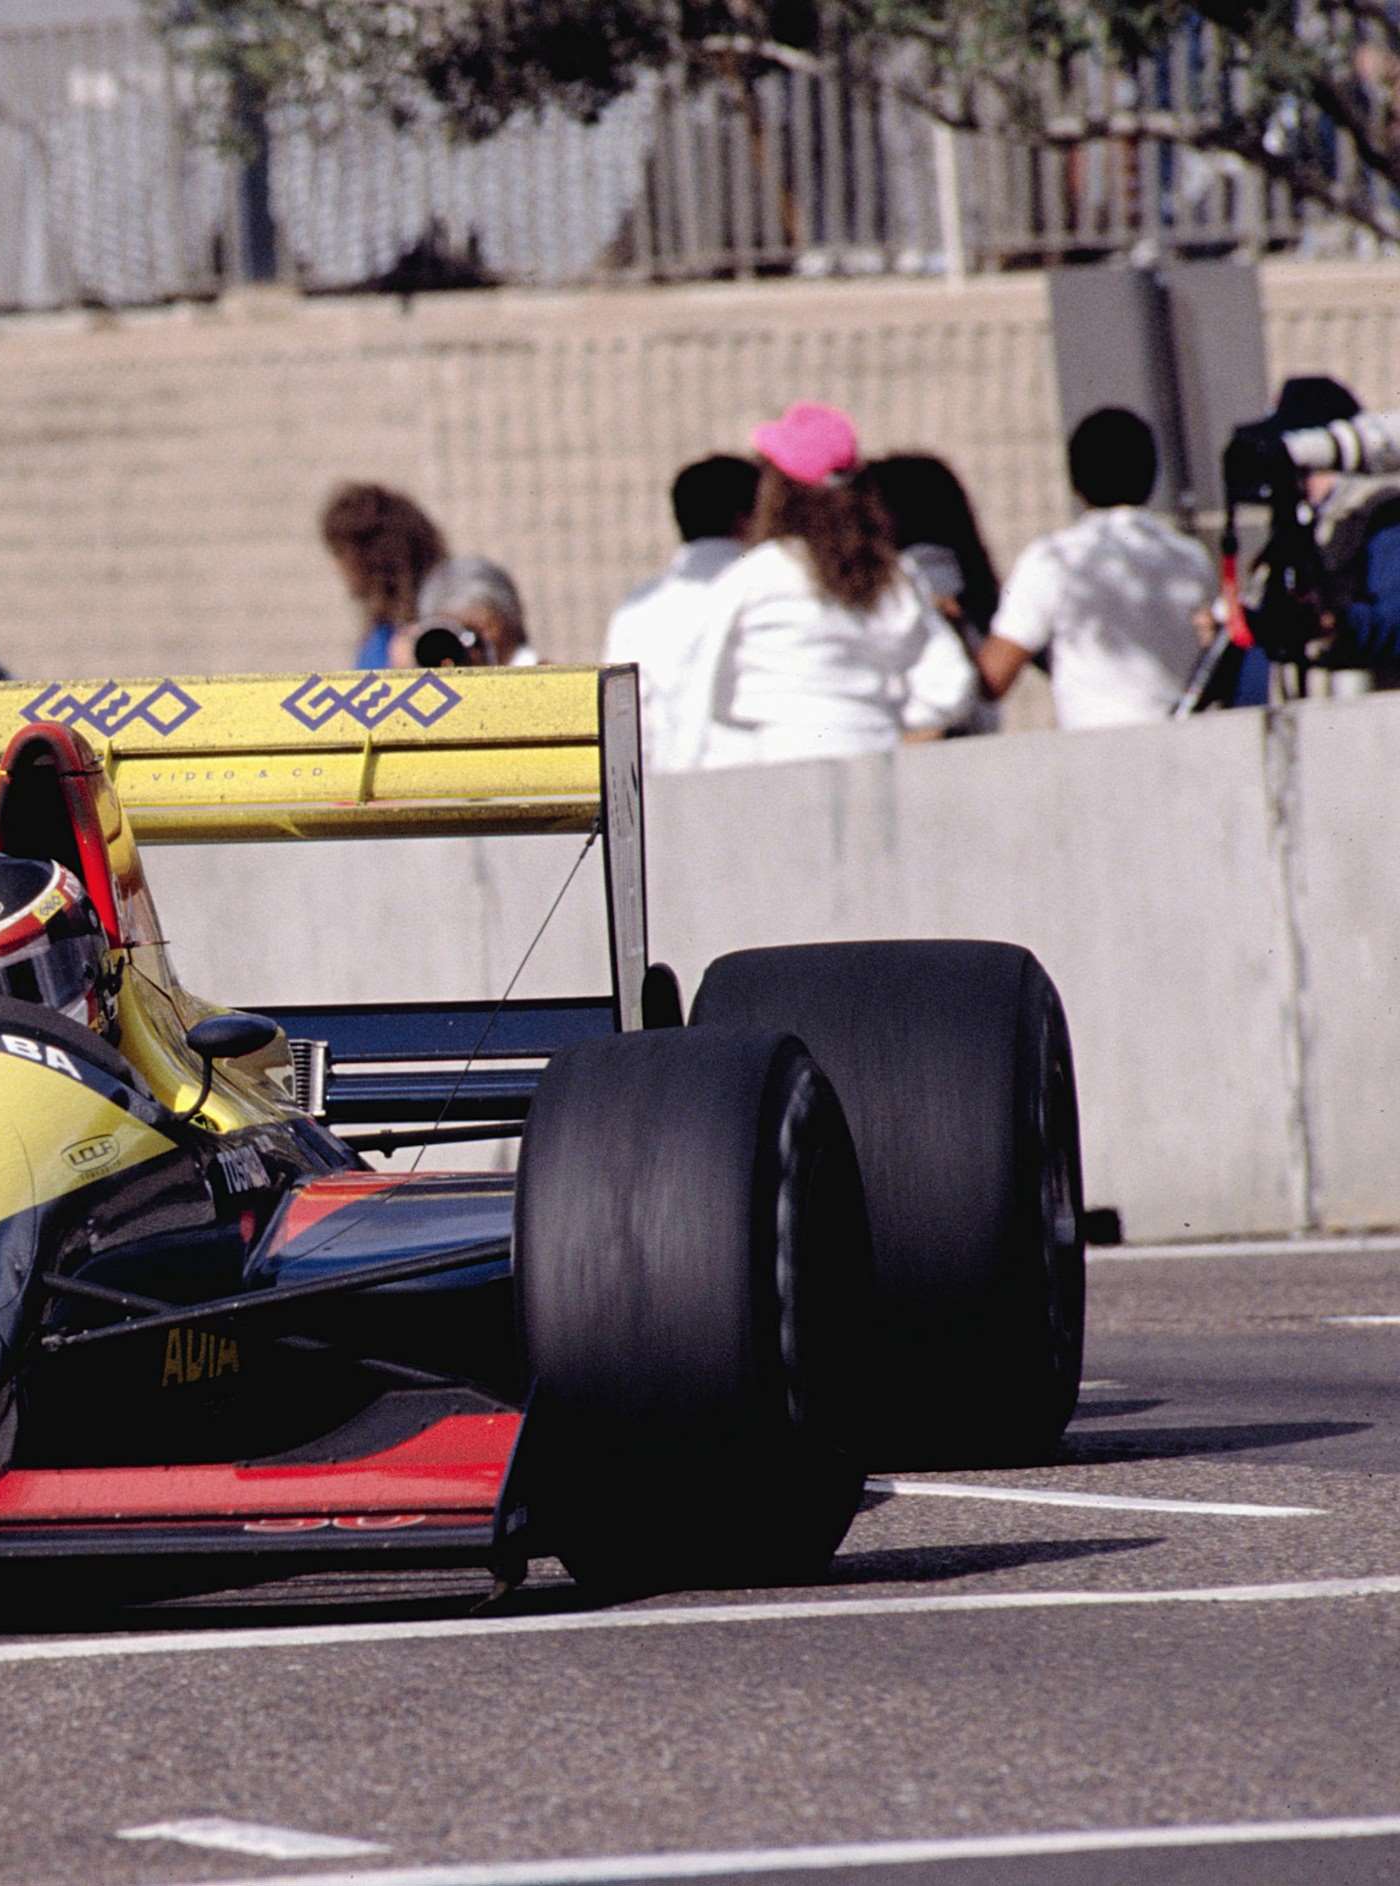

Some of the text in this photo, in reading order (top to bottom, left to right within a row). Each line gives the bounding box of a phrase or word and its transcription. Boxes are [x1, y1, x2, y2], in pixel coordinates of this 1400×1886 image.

[19, 678, 202, 737] GEO
[280, 670, 463, 731] GEO
[151, 767, 324, 782] VIDEO & CD
